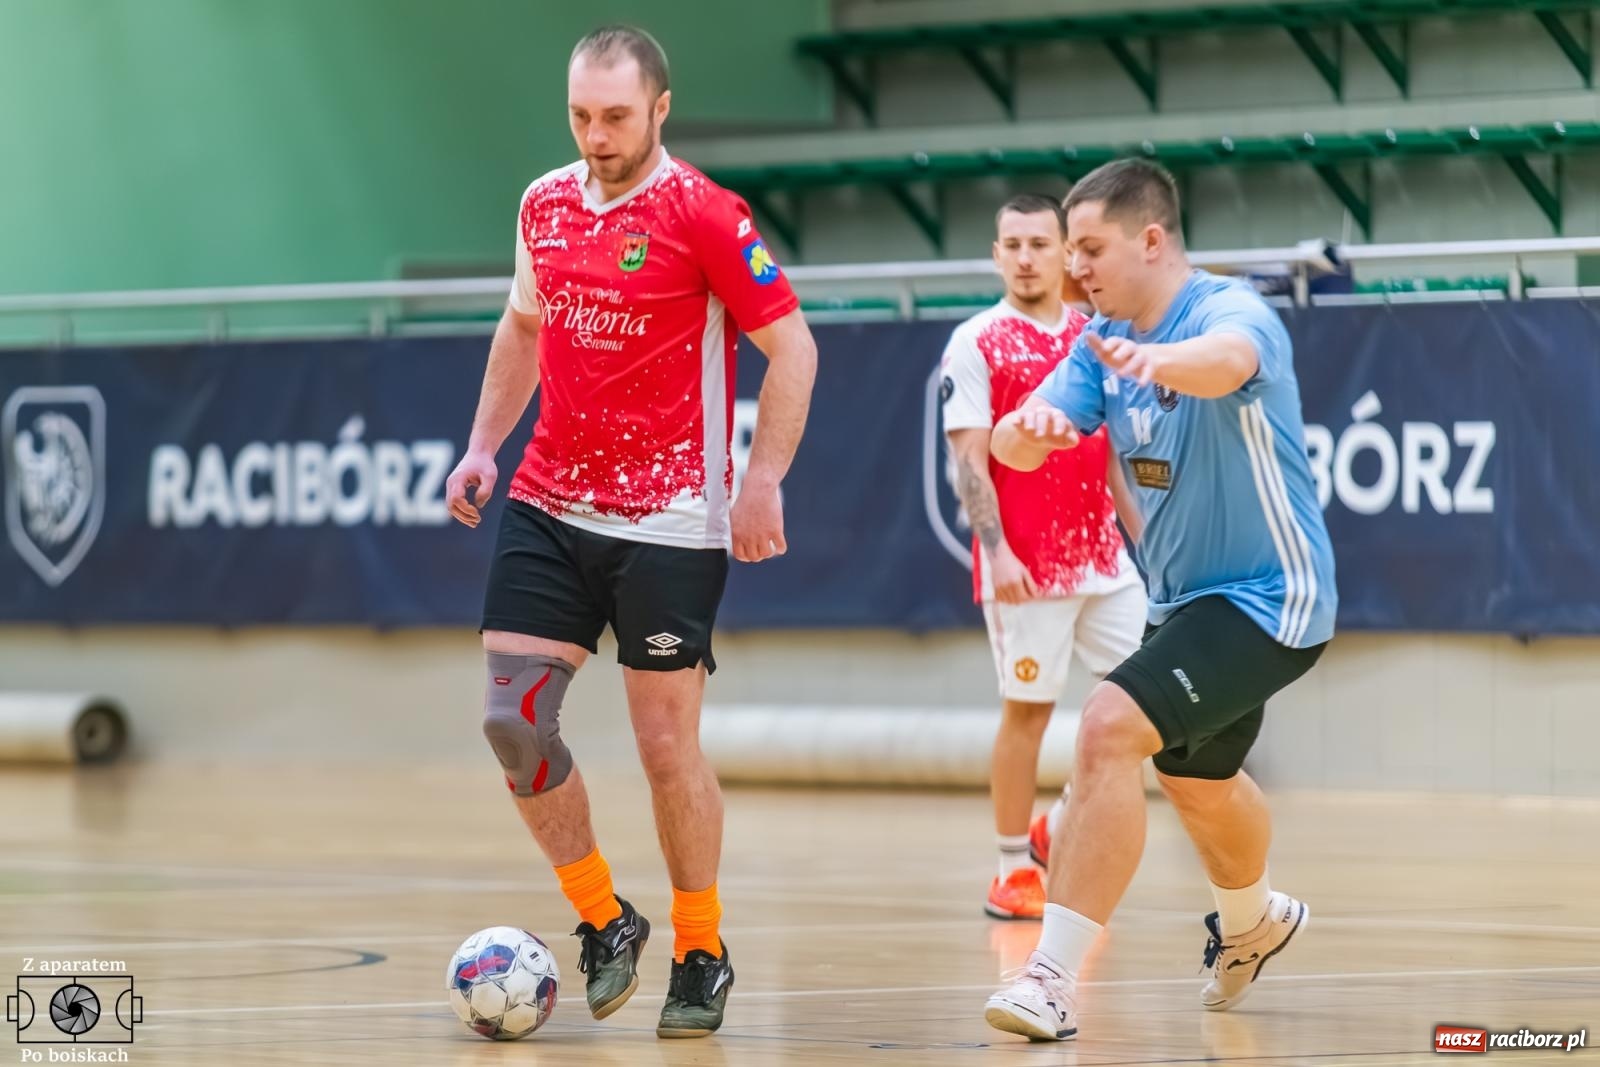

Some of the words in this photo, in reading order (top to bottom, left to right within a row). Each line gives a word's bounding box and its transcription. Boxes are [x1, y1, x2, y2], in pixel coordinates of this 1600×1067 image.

[535, 288, 653, 336] Wiktoria
[571, 331, 626, 351] Brenna
[148, 413, 455, 528] RACIBÓRZ
[648, 647, 678, 656] umbro
